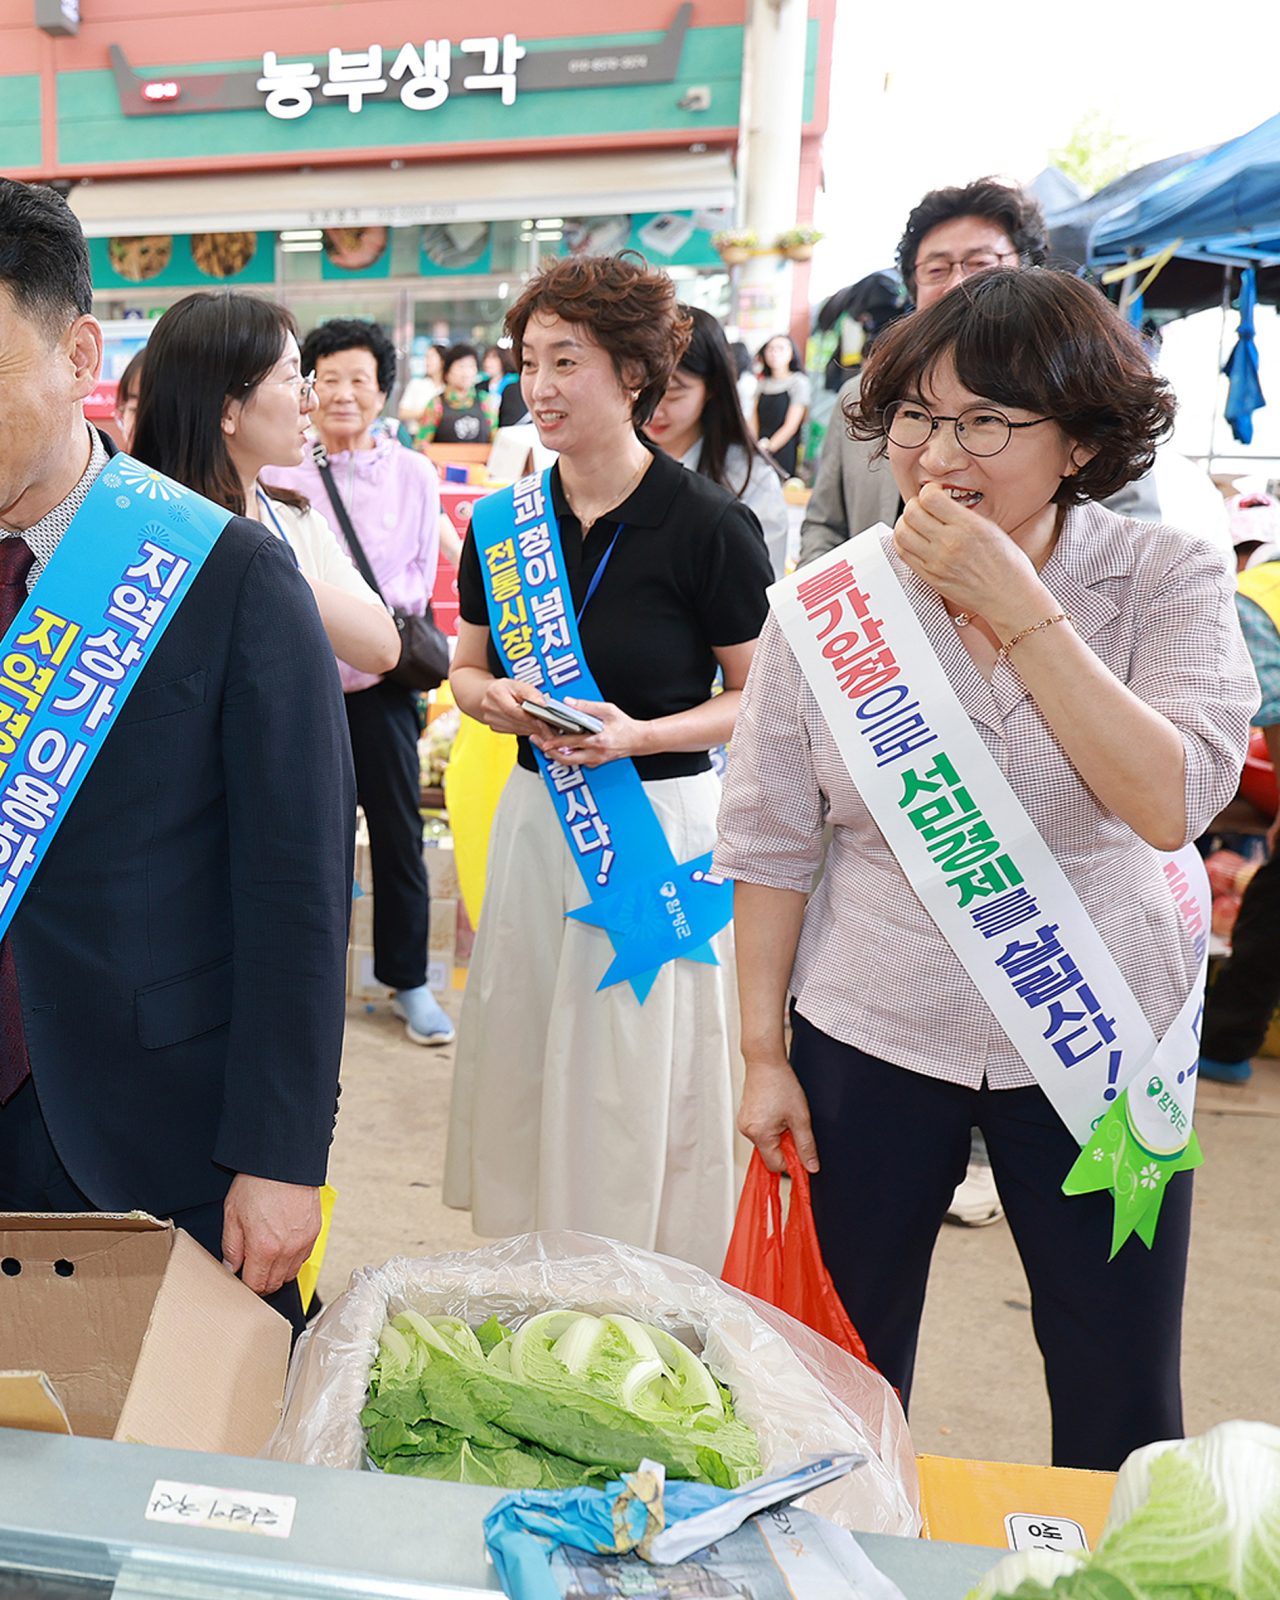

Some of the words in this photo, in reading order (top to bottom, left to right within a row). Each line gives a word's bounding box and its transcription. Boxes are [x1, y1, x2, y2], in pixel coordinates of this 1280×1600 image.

[256, 34, 526, 120] 농부생각
[517, 521, 558, 587] 정이
[53, 541, 191, 732] 지역상가
[484, 537, 545, 688] 전통시장을
[530, 585, 582, 687] 넘치는
[796, 558, 939, 768] 물가안정으로
[897, 751, 1042, 941] 서민경제를
[994, 922, 1122, 1103] 살립시다!
[1158, 1091, 1189, 1136] 함평군
[151, 1493, 200, 1517] 국산
